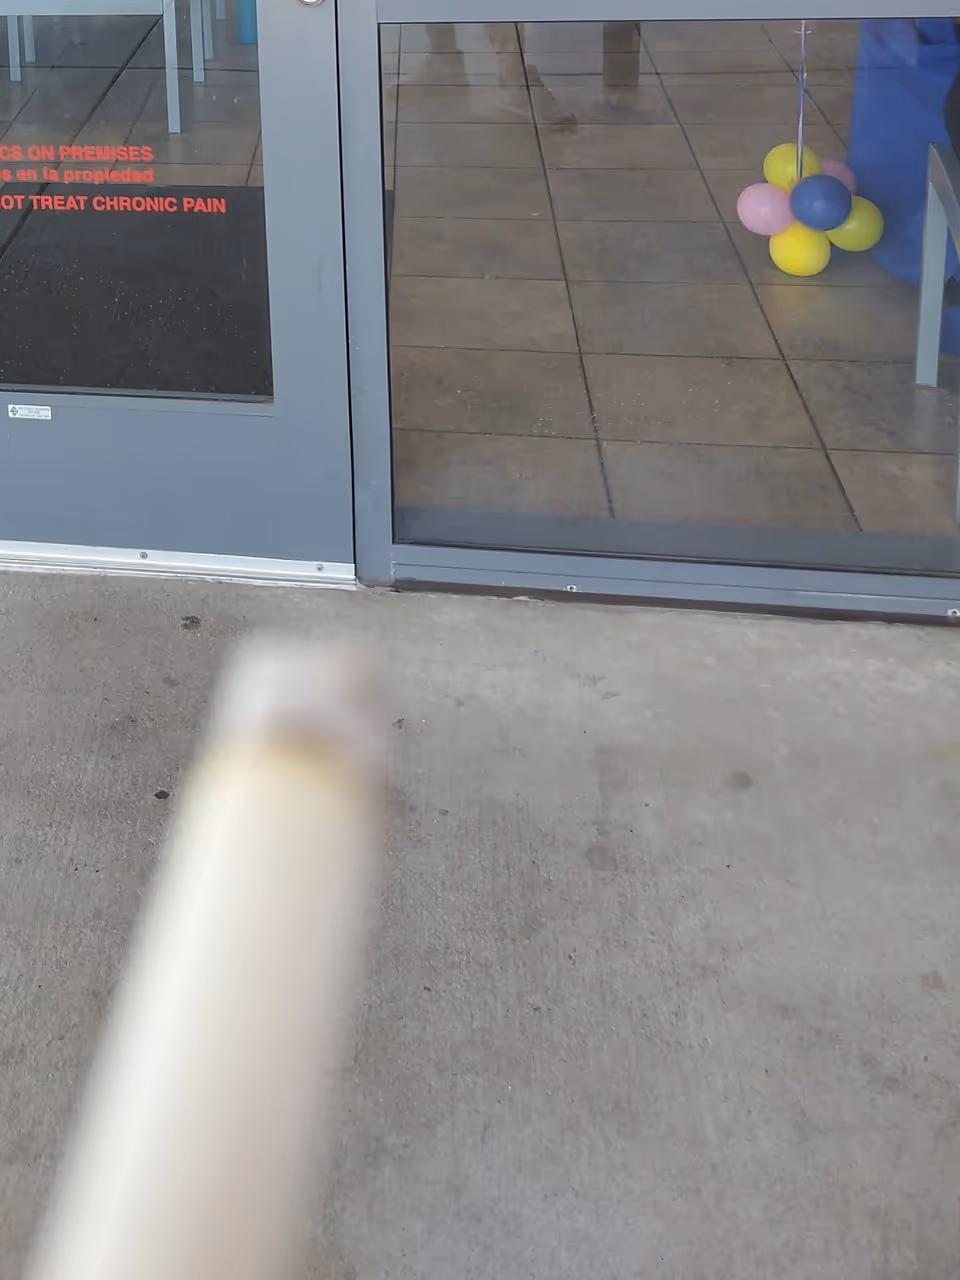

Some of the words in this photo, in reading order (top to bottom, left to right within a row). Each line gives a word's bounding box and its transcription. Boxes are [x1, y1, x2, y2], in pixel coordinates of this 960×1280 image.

[28, 145, 55, 160] ON
[59, 145, 154, 161] PREMISES
[16, 169, 38, 181] en
[43, 167, 59, 181] la
[64, 167, 154, 185] propiedad
[29, 195, 88, 211] TREAT
[92, 196, 179, 213] CHRONIC
[182, 198, 226, 214] PAIN
